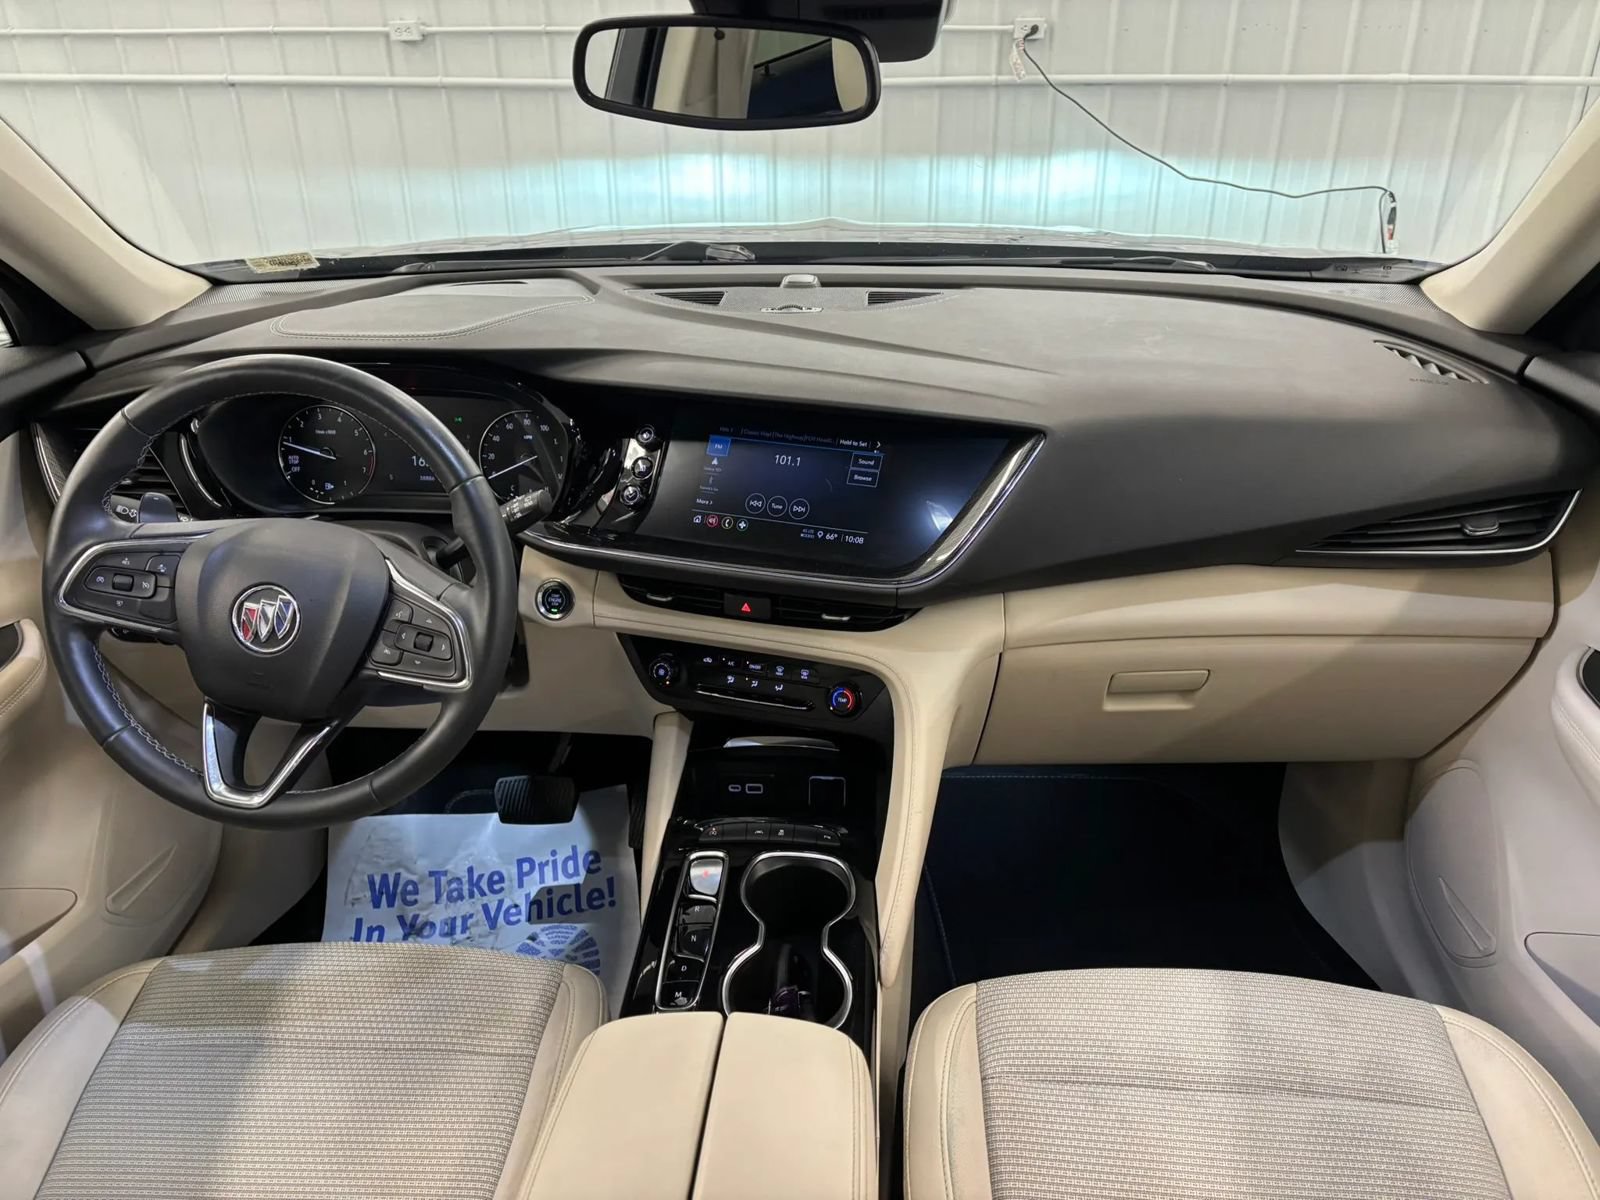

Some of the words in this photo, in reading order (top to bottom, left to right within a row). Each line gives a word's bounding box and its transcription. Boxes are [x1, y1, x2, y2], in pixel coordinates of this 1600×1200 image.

[859, 440, 868, 448] Set
[774, 454, 801, 467] 101.1
[858, 458, 875, 466] Sound
[854, 474, 872, 482] Browse
[696, 498, 708, 506] More
[844, 535, 865, 545] 10:08
[366, 871, 420, 910] We
[428, 865, 506, 905] Take
[515, 844, 603, 890] Pride
[352, 916, 386, 943] In
[396, 911, 475, 942] Your
[481, 876, 617, 932] Vehicle!
